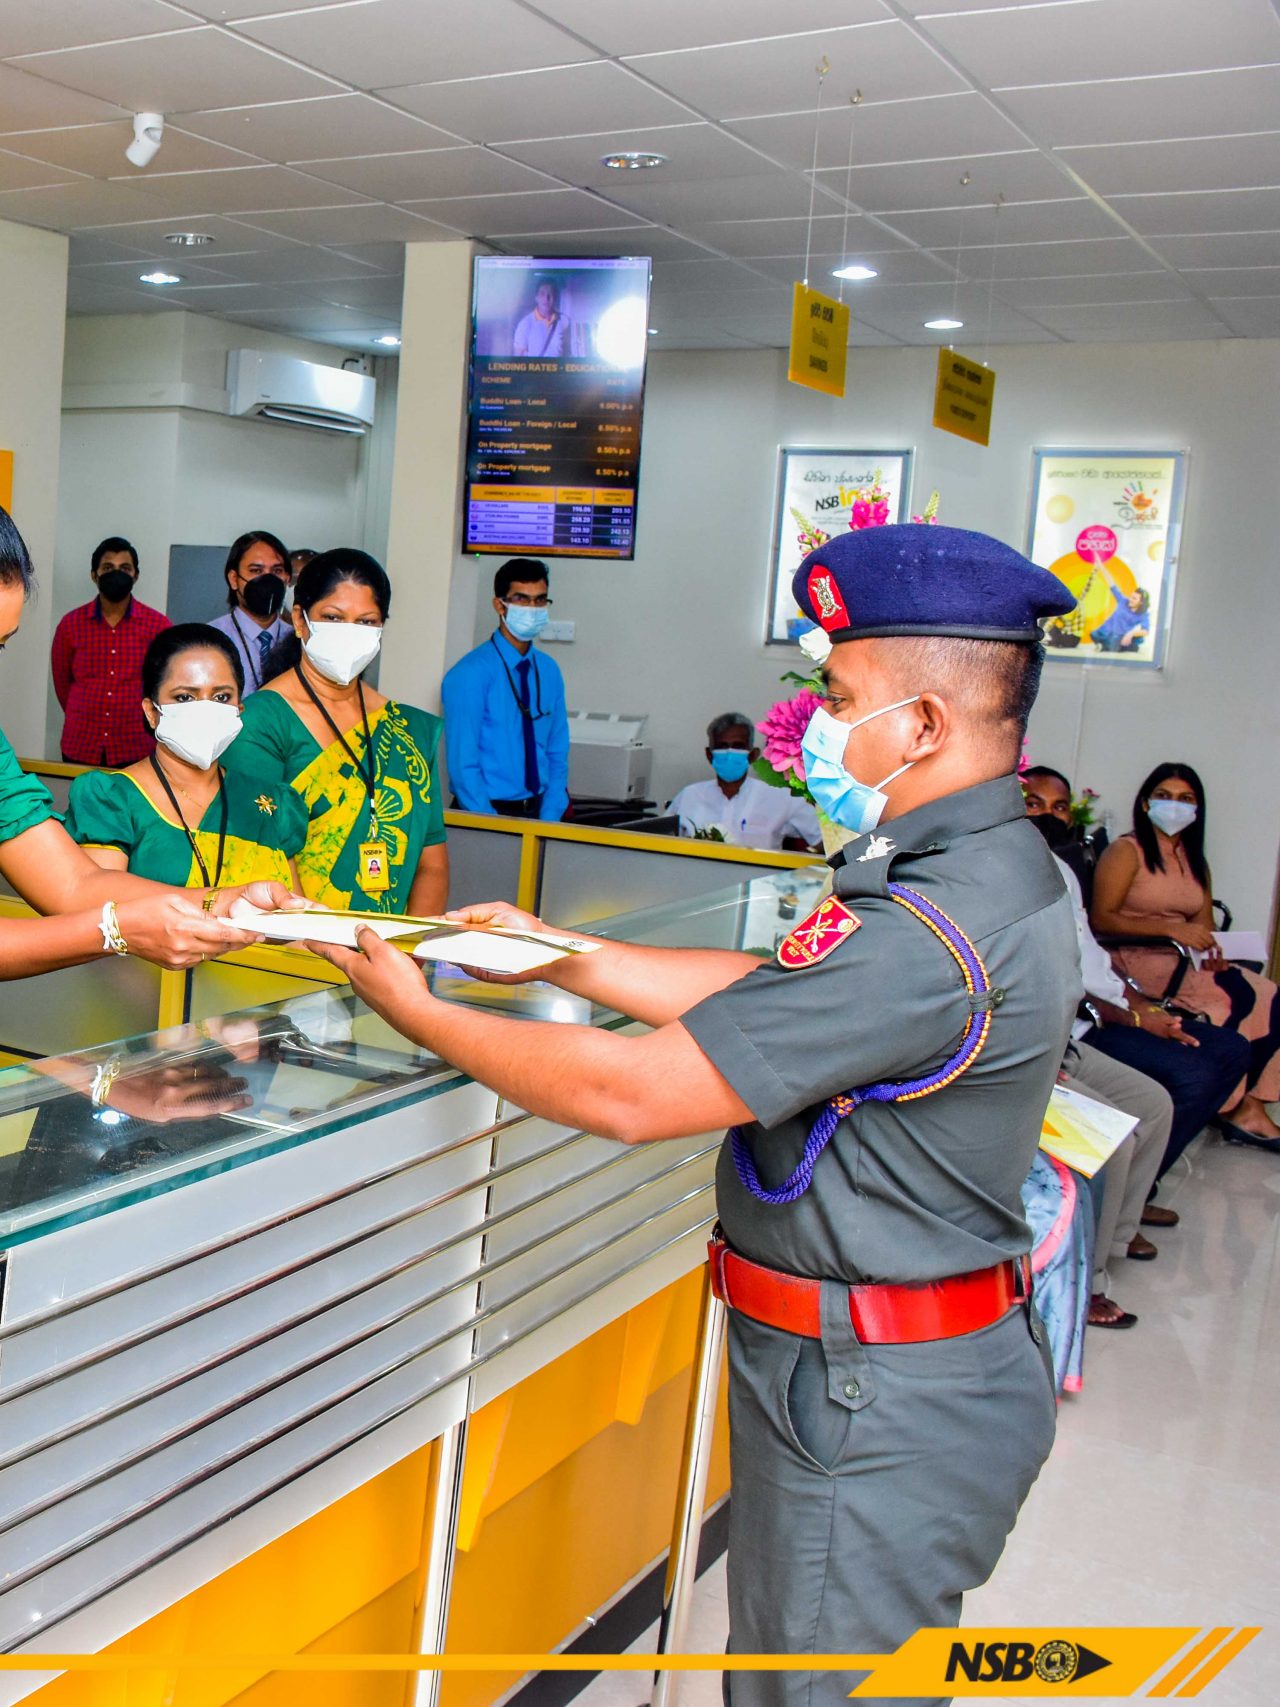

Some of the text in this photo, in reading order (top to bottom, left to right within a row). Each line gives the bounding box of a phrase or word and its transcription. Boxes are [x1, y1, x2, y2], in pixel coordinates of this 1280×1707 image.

[488, 362, 527, 372] LENDING
[528, 363, 558, 372] RATES
[815, 495, 840, 512] NSB
